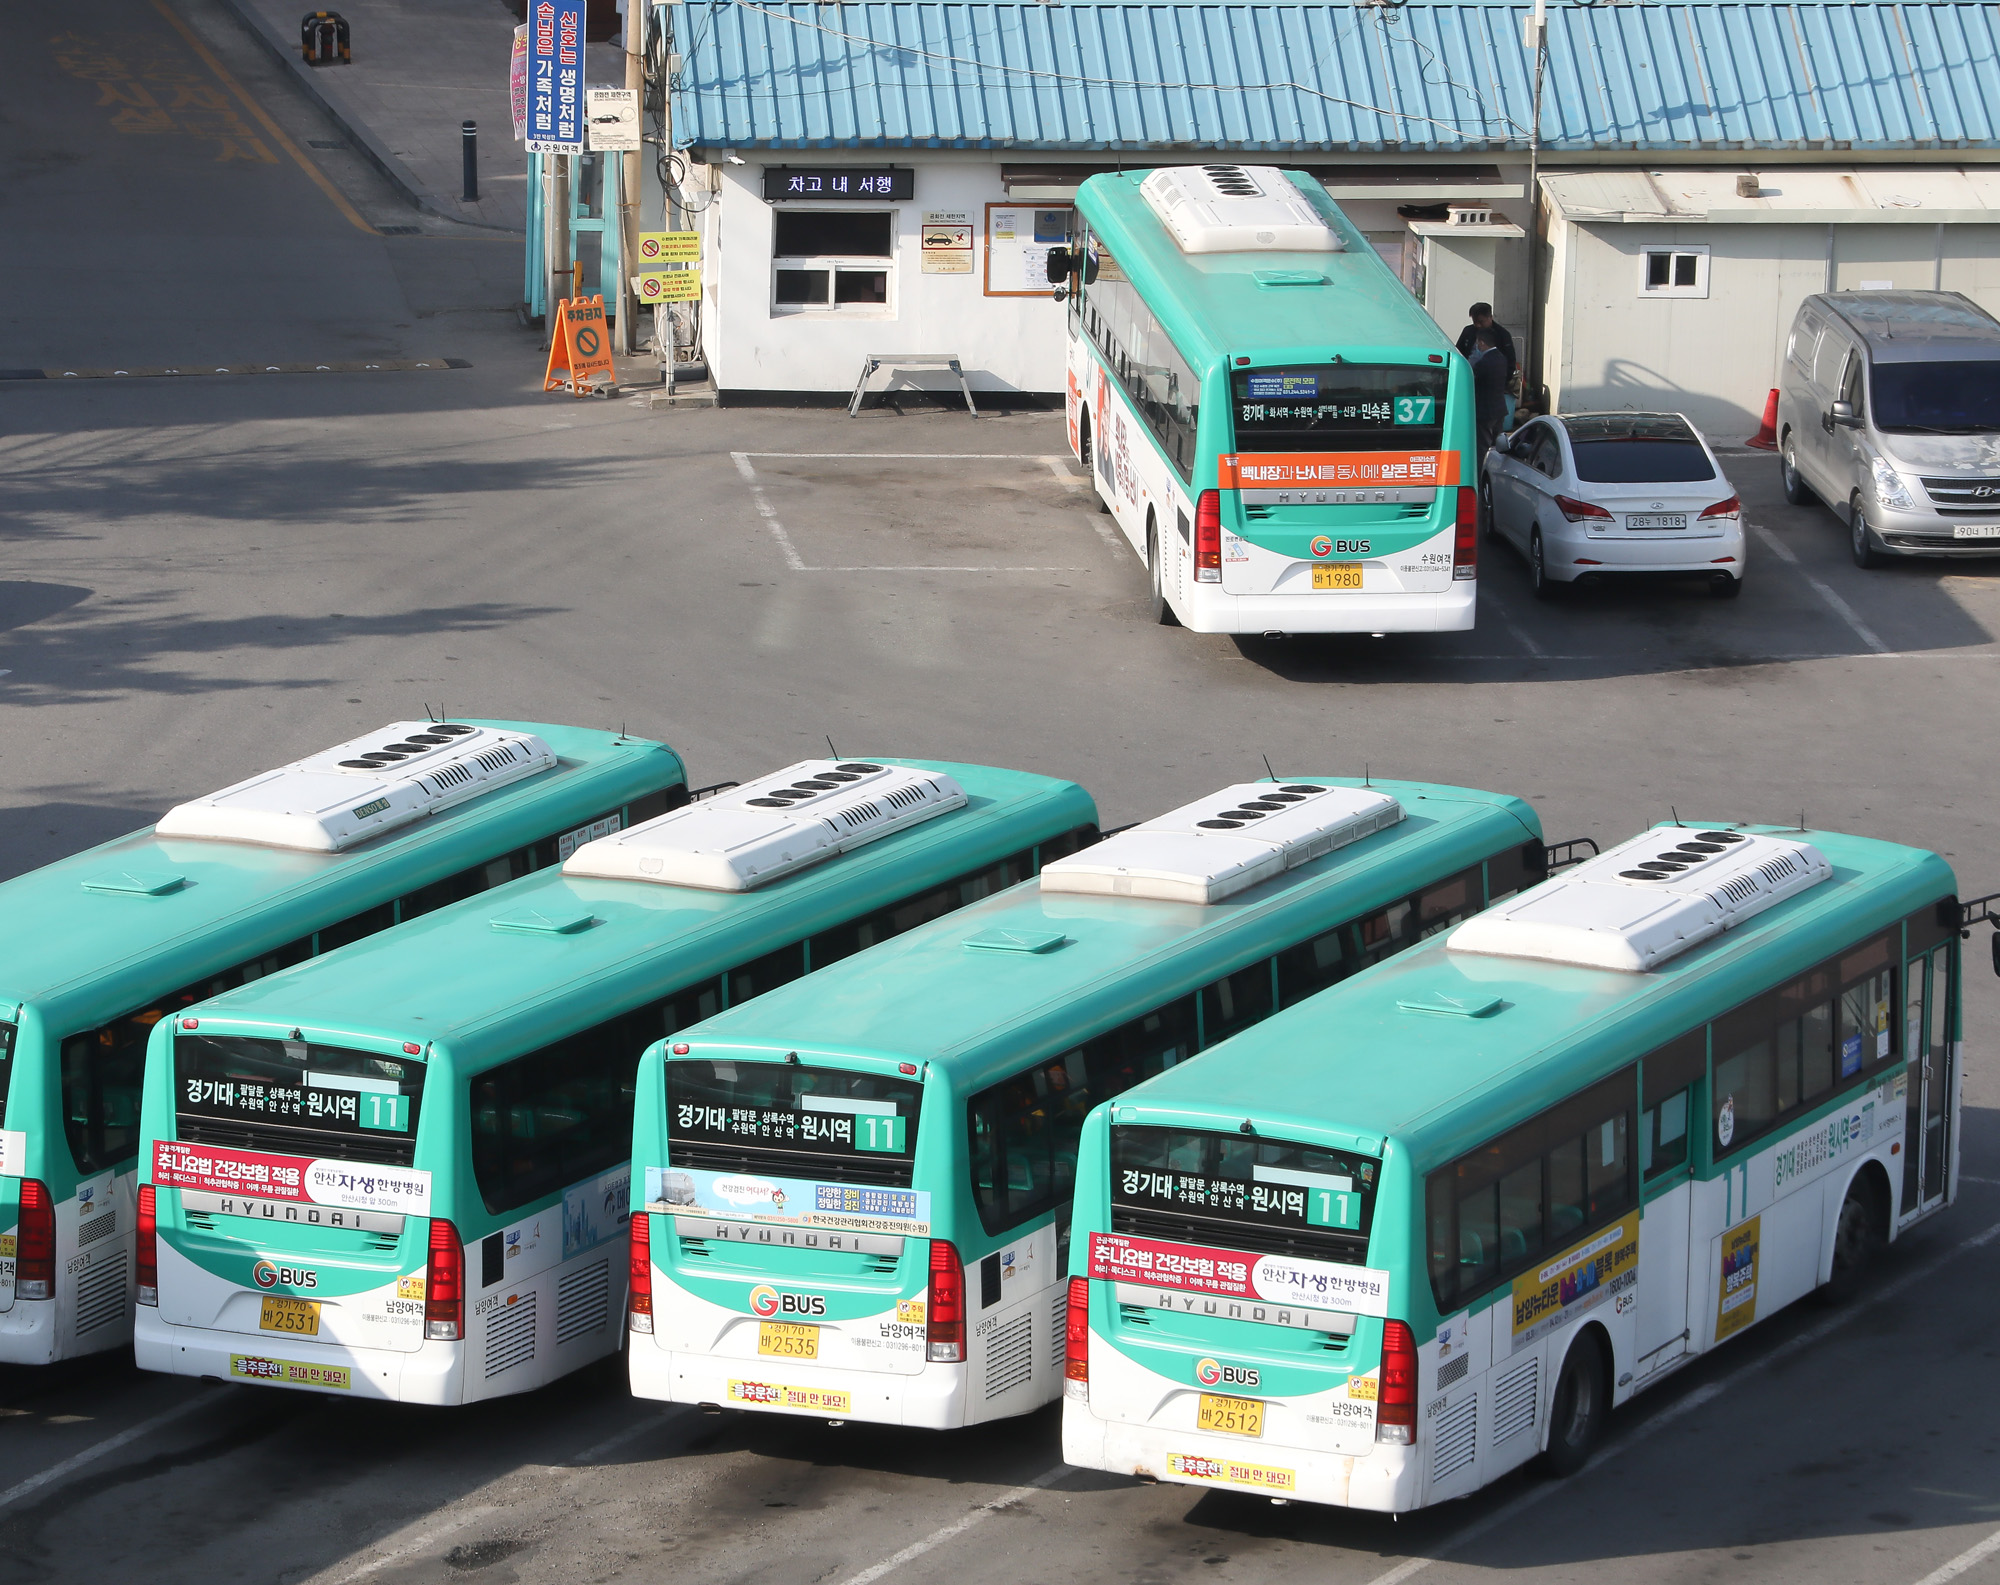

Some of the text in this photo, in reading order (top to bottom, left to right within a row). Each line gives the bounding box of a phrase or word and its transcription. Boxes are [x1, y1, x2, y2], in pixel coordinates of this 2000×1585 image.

[536, 2, 554, 130] 손님은 가족처럼
[559, 12, 577, 139] 신호는 생명처럼
[544, 144, 579, 153] 수원여객
[788, 176, 892, 194] 차고 내 서행
[567, 307, 602, 322] 주차금지
[1243, 398, 1431, 422] 경기대 화서역 수원역 신갈 민속촌 37
[1241, 463, 1436, 481] 백내장과 난시를 동시에! 알콘 토릭
[1279, 491, 1400, 503] HYUNDAI
[1632, 517, 1681, 527] 28누 1818
[1960, 527, 1978, 536] 90너
[1421, 553, 1451, 564] 수원여객
[355, 803, 378, 818] DENSO
[187, 1079, 397, 1127] 경기대 팔달문 상록수역 원시역 11
[239, 1097, 264, 1112] 수원역
[678, 1104, 893, 1149] 경기대 팔달문 상록수역 원시역 11
[731, 1122, 757, 1136] 수원역
[1776, 1146, 1796, 1186] 경기대
[1829, 1115, 1849, 1159] 원시역
[158, 1153, 300, 1186] 추나요법 건강보험 적용
[203, 1177, 239, 1190] 척추관협착증
[274, 1185, 299, 1196] 관절질환
[722, 1184, 769, 1196] 건강검진 어디서?
[817, 1187, 860, 1200] 다양한 장비
[1722, 1159, 1748, 1228] 11
[341, 1194, 367, 1204] 안산시청
[377, 1198, 398, 1207] 300m
[817, 1198, 860, 1211] 정밀한 검진
[1122, 1169, 1348, 1225] 경기대 팔달문 상록수역 원시역 11
[1178, 1190, 1205, 1205] 수원역
[221, 1199, 360, 1228] HYUNDAI
[716, 1224, 859, 1250] HYUNDAI
[67, 1253, 91, 1274] 남양여객
[1095, 1245, 1247, 1282] 추나요법 건강보험 적용
[412, 1281, 423, 1289] 주의
[1143, 1271, 1182, 1284] 척추관협착증
[1220, 1281, 1246, 1293] 관절질환
[1516, 1282, 1559, 1326] 남양뉴타운
[1614, 1241, 1637, 1266] 행복주택
[276, 1300, 307, 1311] 경기 70
[475, 1294, 499, 1316] 남양여객
[1292, 1291, 1320, 1303] 안산시청
[1330, 1296, 1352, 1306] 300m
[386, 1301, 424, 1316] 남양여객
[912, 1305, 923, 1313] 주의
[1159, 1294, 1309, 1327] HYUNDAI
[774, 1324, 805, 1335] 경기 70
[880, 1323, 925, 1340] 남양여객
[976, 1316, 998, 1337] 남양여객
[237, 1359, 346, 1384] 음주운전! 절대 안 돼요!
[1364, 1381, 1376, 1389] 주의
[734, 1383, 846, 1408] 음주운전! 절대 안 돼요!
[1216, 1399, 1248, 1410] 경기 70
[1332, 1402, 1372, 1419] 남양여객
[1427, 1396, 1447, 1419] 남양여객
[1174, 1457, 1291, 1486] 음주운전! 절대 안 돼요!
